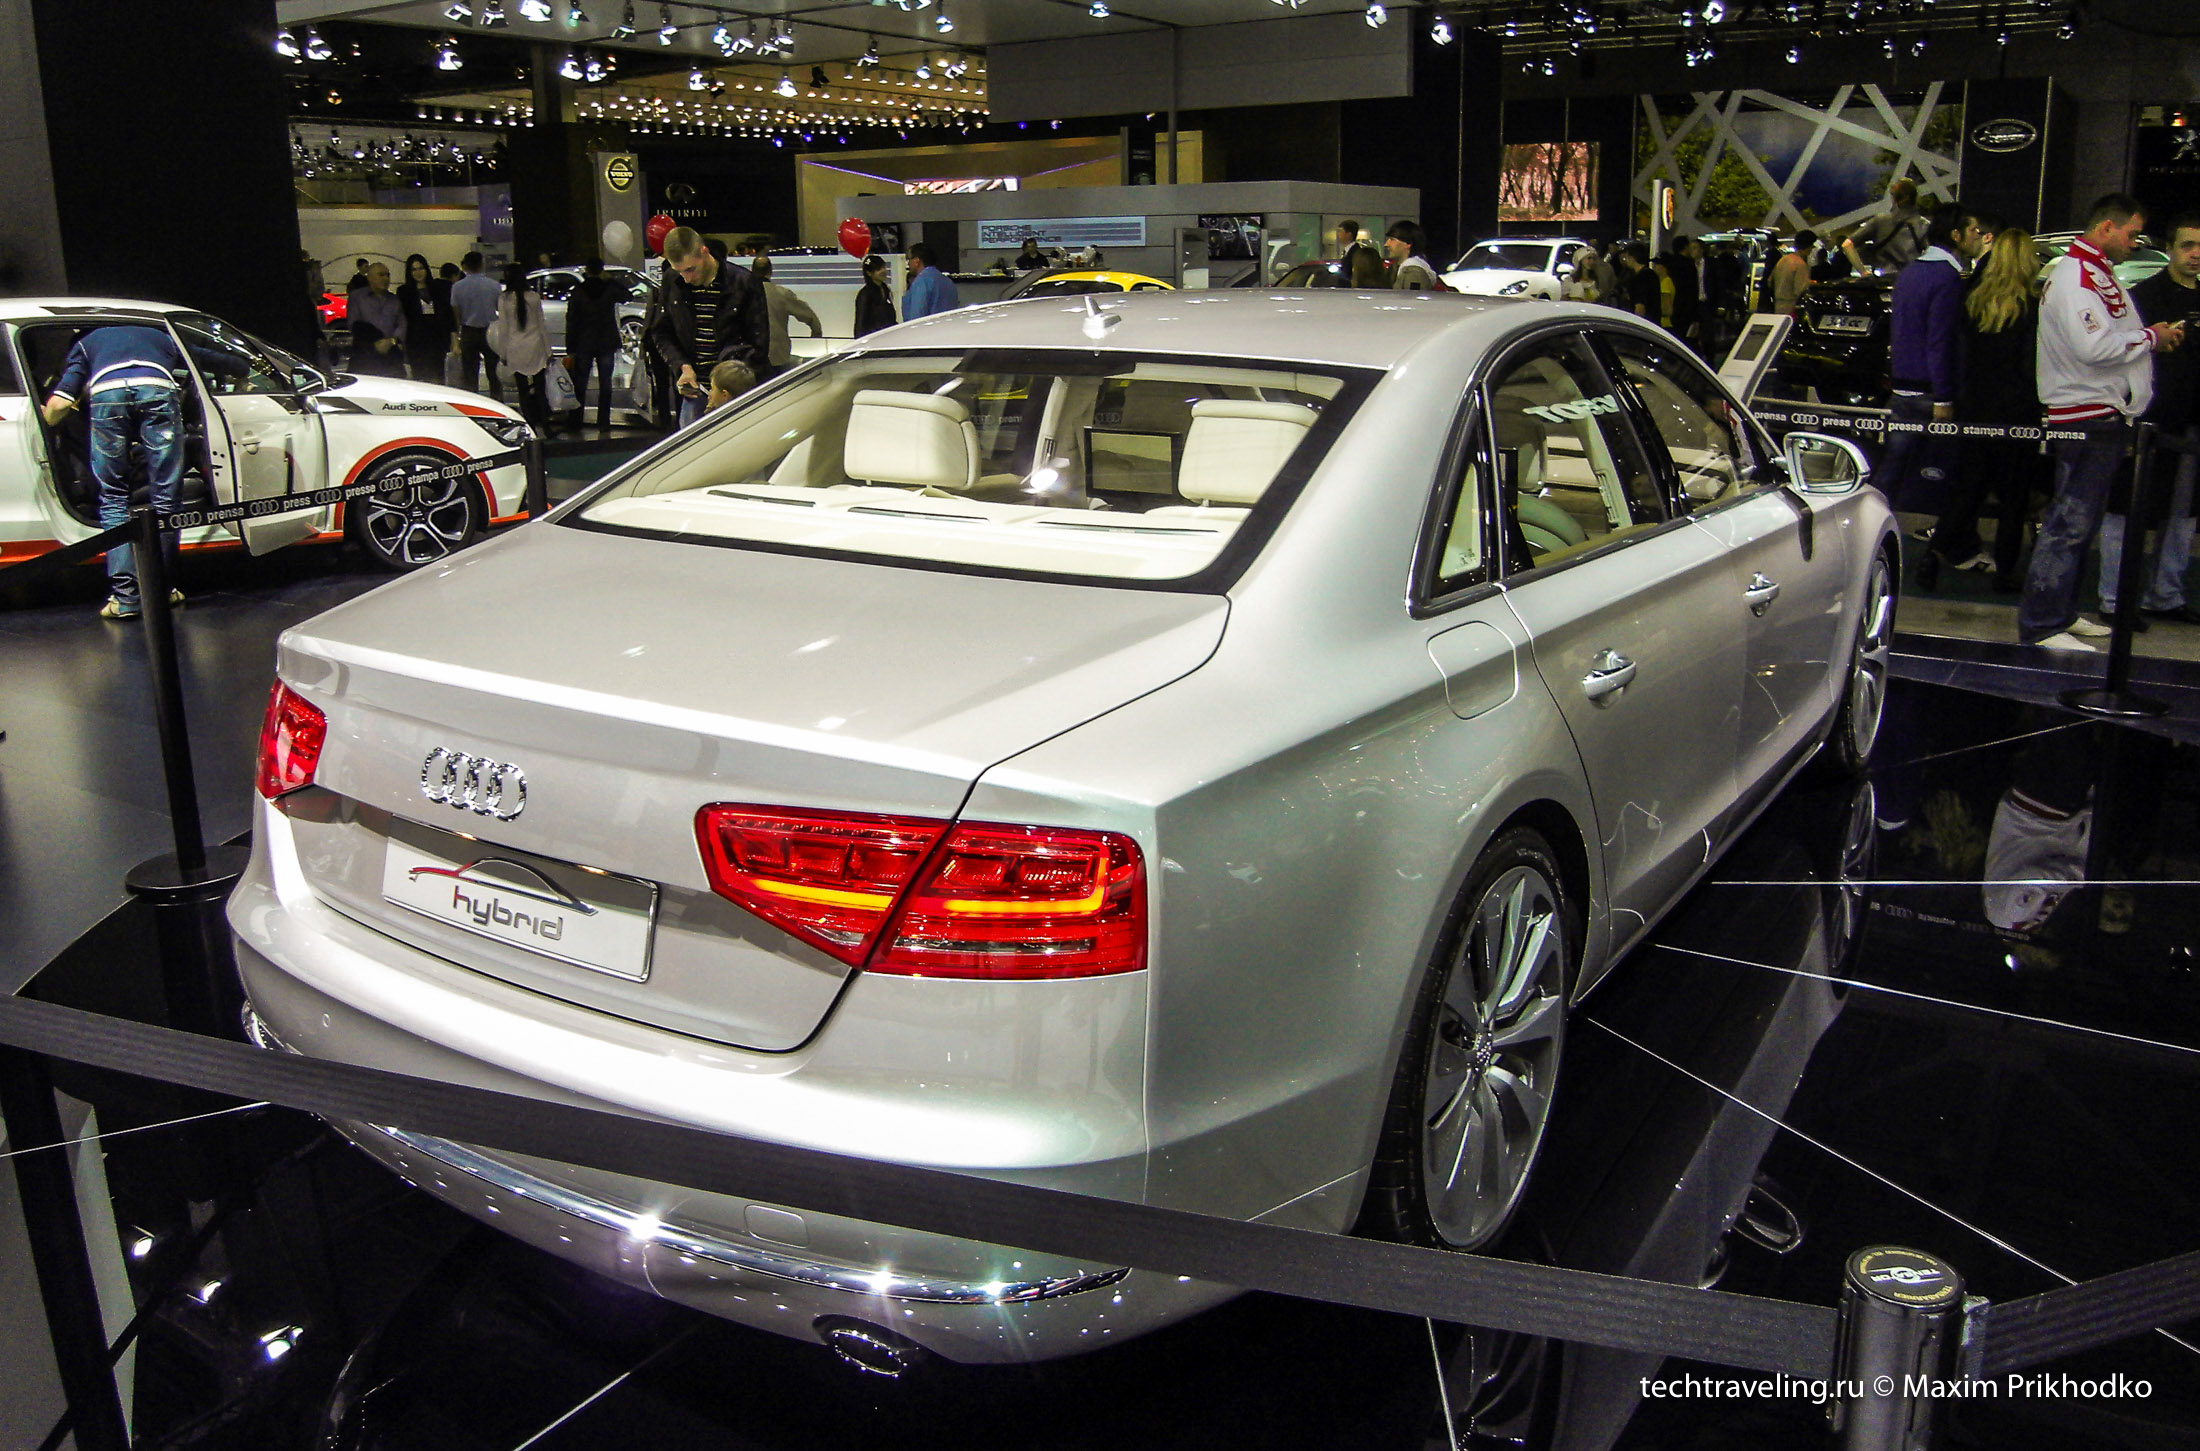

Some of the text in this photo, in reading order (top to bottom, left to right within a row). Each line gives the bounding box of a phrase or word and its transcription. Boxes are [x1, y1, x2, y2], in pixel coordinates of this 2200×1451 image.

[610, 170, 634, 178] VOLVO
[981, 224, 1032, 232] PORSCHE
[382, 402, 438, 412] Audi Sport
[1754, 411, 2087, 441] prensa press presse stampa prensa
[206, 459, 494, 523] prensa press presse stampa prensa
[452, 885, 564, 941] hybrid
